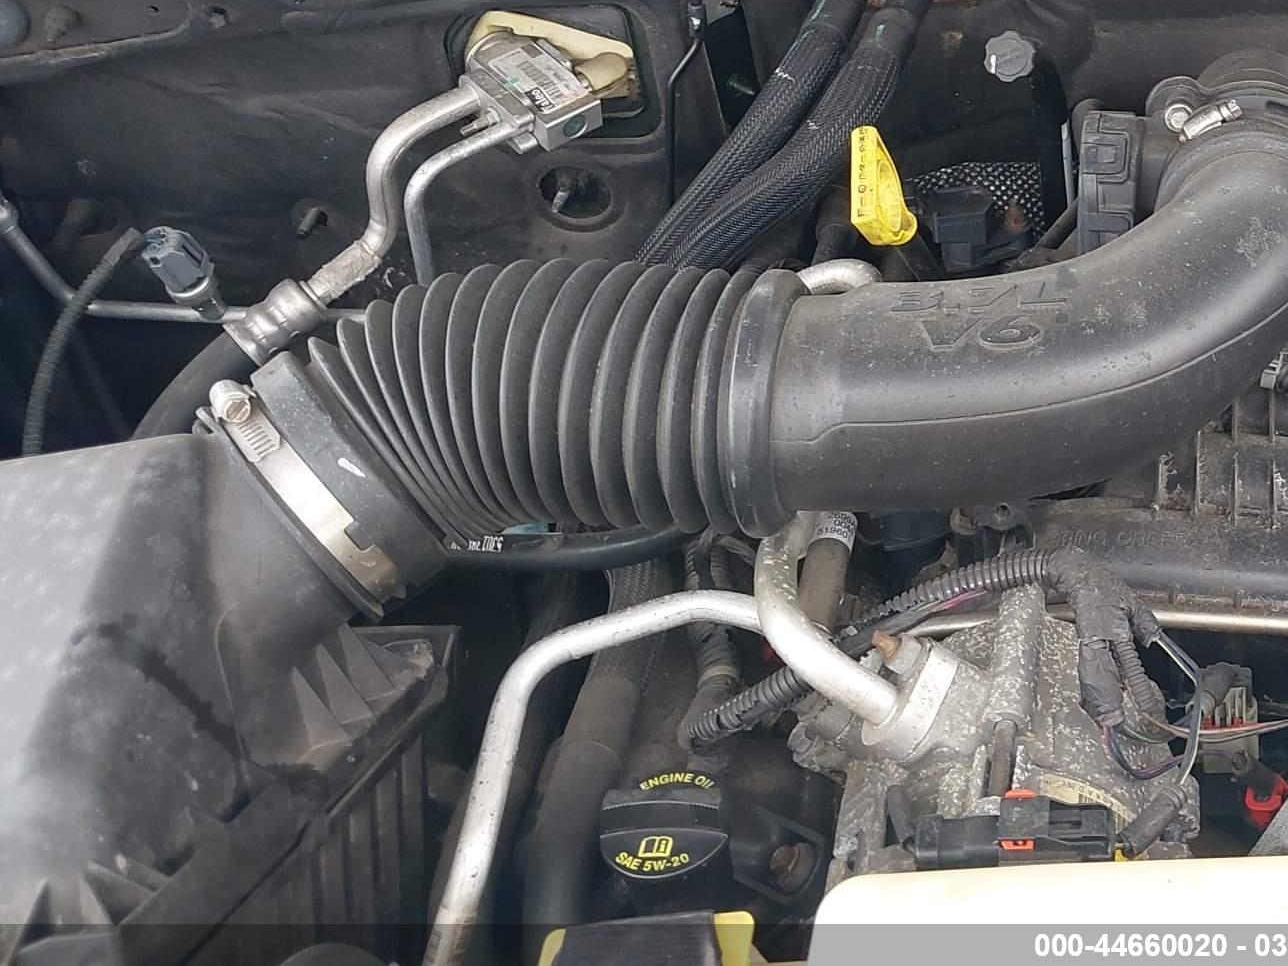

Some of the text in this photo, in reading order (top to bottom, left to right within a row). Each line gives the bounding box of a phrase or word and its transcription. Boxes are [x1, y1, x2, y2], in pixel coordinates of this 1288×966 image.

[920, 313, 1042, 352] V6
[639, 772, 695, 790] ENGINE
[615, 851, 690, 872] SAE 5W-20
